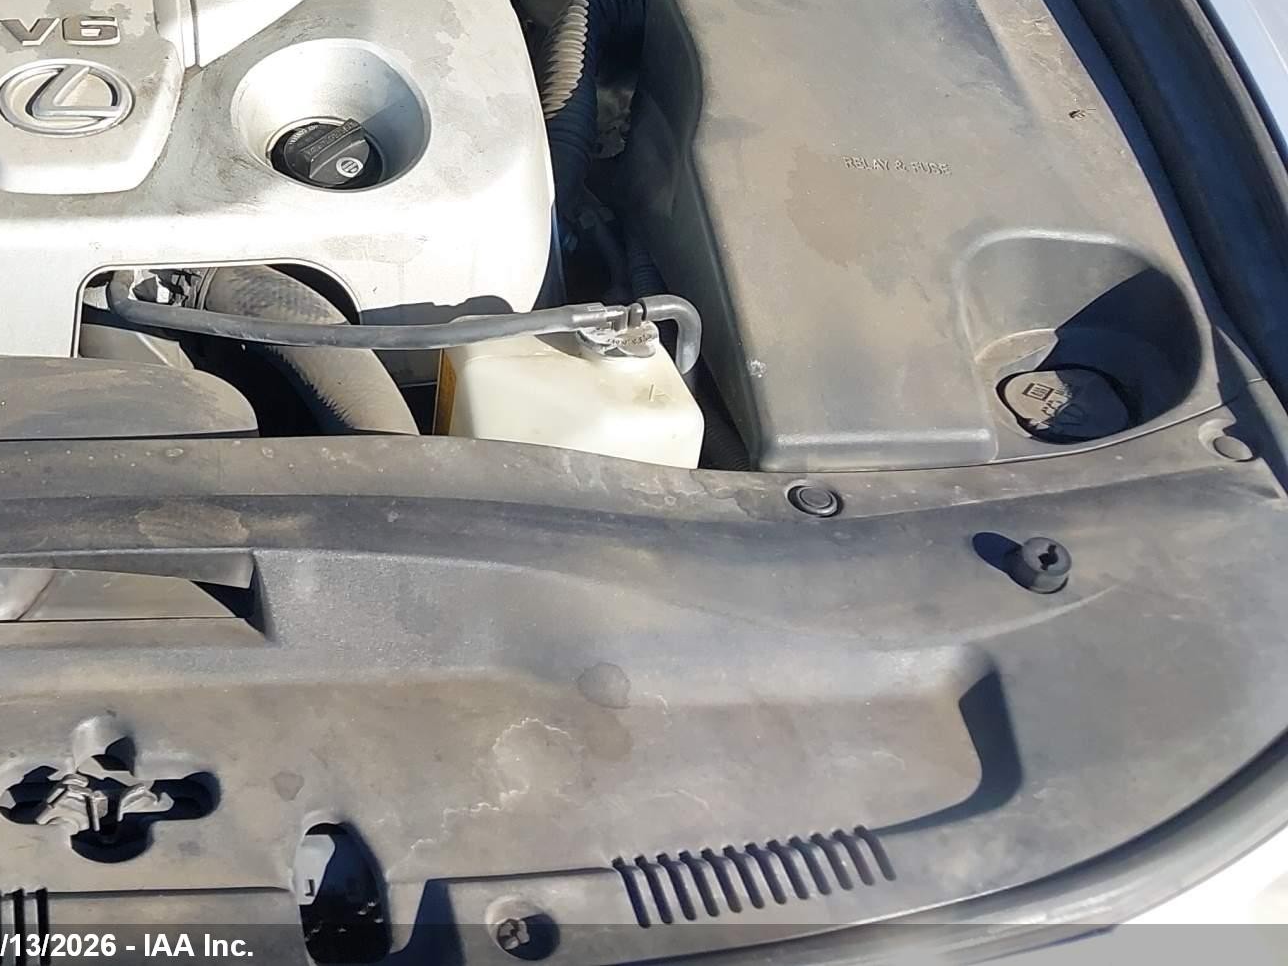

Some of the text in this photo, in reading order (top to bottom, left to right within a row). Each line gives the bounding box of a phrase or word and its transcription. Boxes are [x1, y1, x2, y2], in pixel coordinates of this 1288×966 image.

[0, 14, 120, 46] V6
[841, 155, 954, 176] RELAY & FUSE
